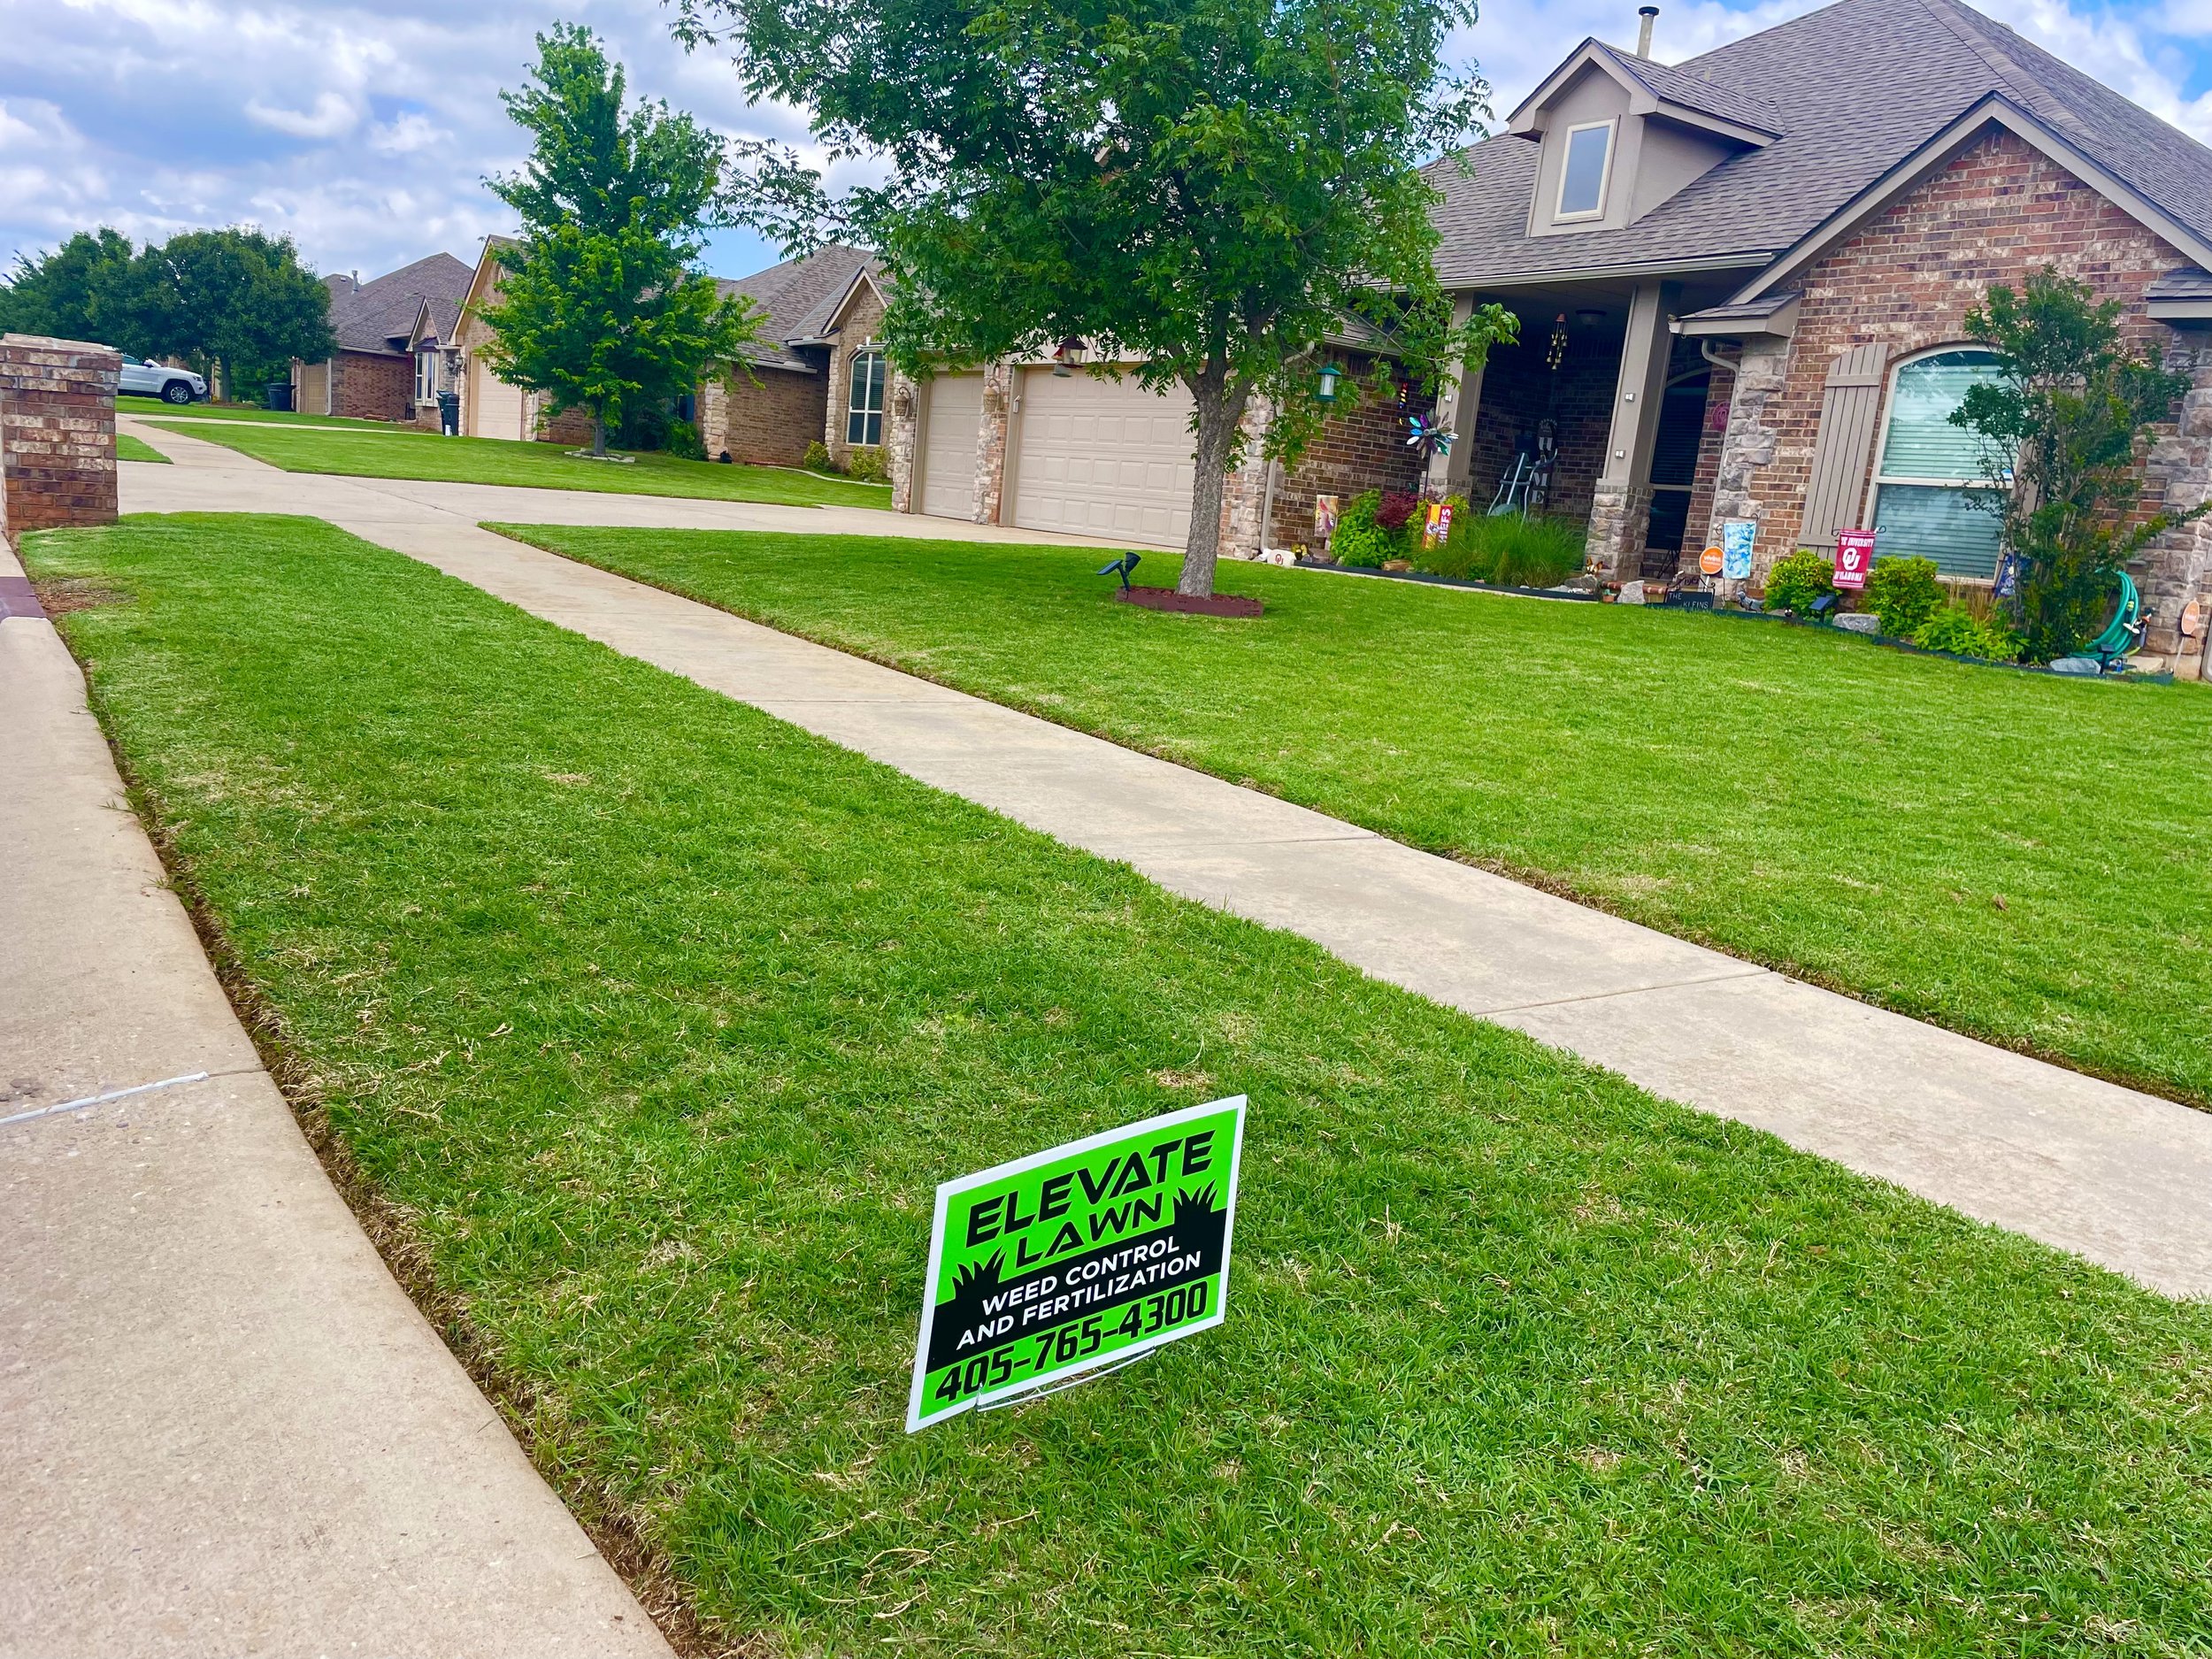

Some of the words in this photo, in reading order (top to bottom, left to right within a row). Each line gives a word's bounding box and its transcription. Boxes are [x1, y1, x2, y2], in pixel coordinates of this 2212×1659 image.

[1669, 592, 1683, 601] THE
[1842, 548, 1861, 571] OU
[965, 1129, 1216, 1248] ELEVATE
[1016, 1192, 1164, 1269] LAWN
[956, 1316, 1015, 1350] AND
[1022, 1251, 1202, 1325] FERTILIZATION
[982, 1275, 1057, 1317] WEED
[1065, 1236, 1180, 1286] CONTROL
[935, 1281, 1208, 1402] 405-765-4300
